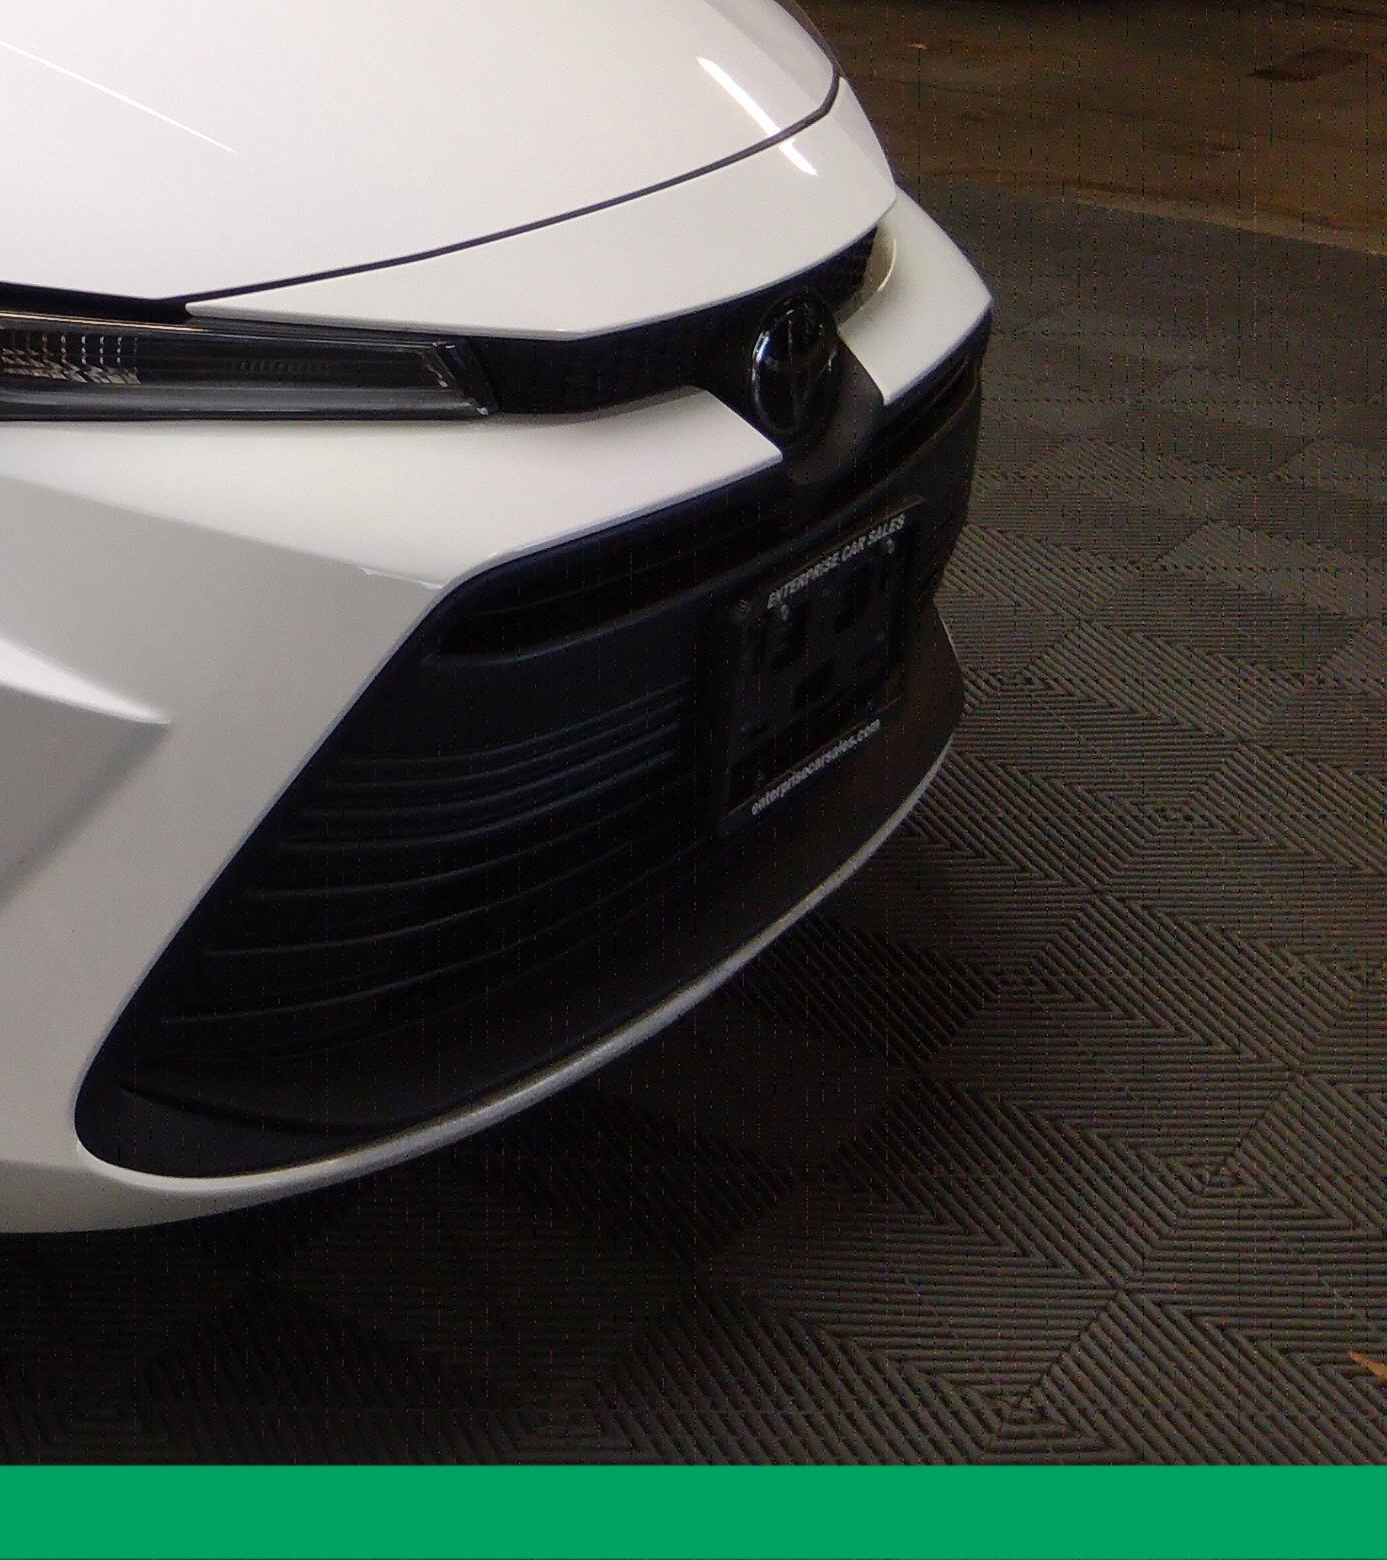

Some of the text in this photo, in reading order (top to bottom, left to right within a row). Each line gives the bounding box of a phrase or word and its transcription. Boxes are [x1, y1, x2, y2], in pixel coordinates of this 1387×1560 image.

[767, 512, 906, 609] ENTERPRISE CAR SALES
